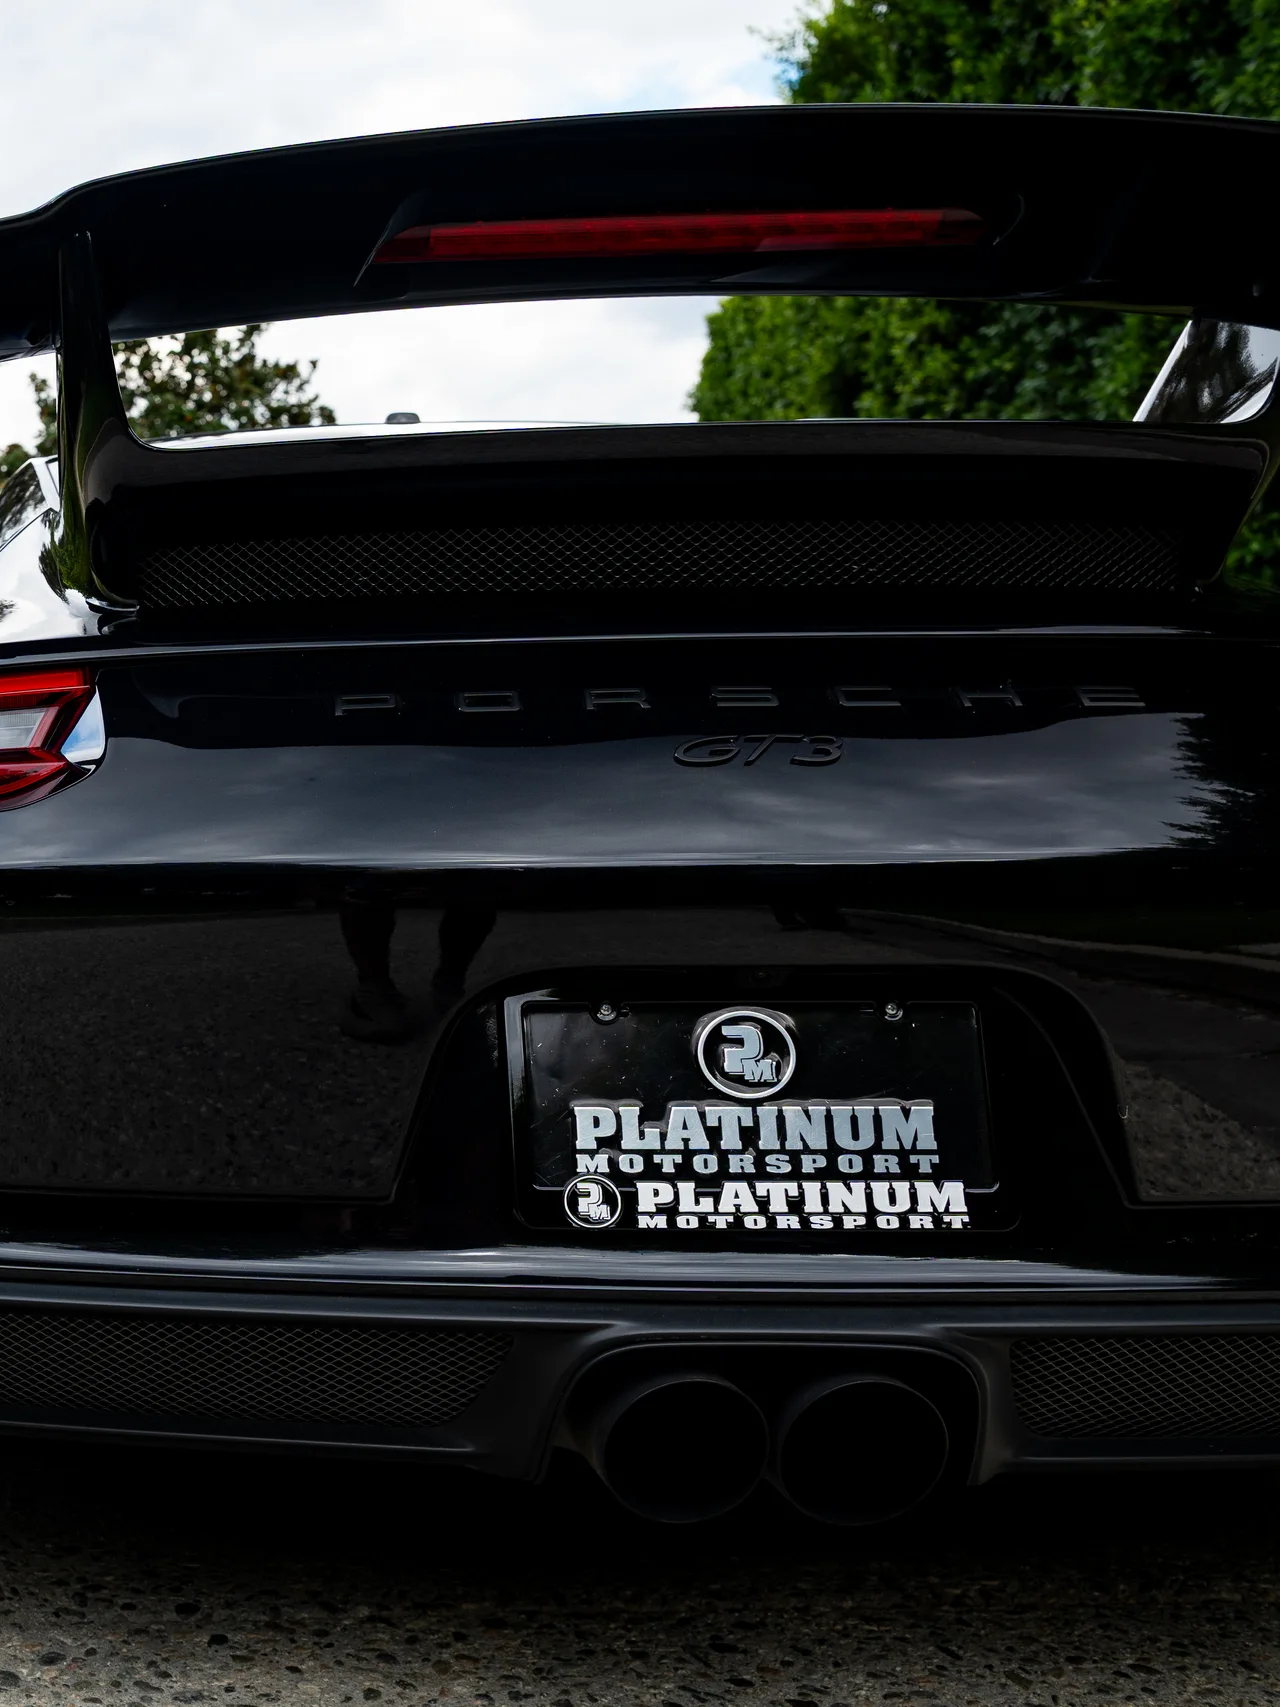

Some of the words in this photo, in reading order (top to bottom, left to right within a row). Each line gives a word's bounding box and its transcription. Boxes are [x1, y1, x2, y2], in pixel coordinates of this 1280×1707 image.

[334, 685, 1147, 717] PORSCHE
[673, 733, 843, 767] GT3
[574, 1106, 938, 1150] PLATINUM
[575, 1153, 940, 1174] MOTORSPORT
[636, 1181, 968, 1213] PLATINUM
[637, 1215, 969, 1229] MOTORSPORT
